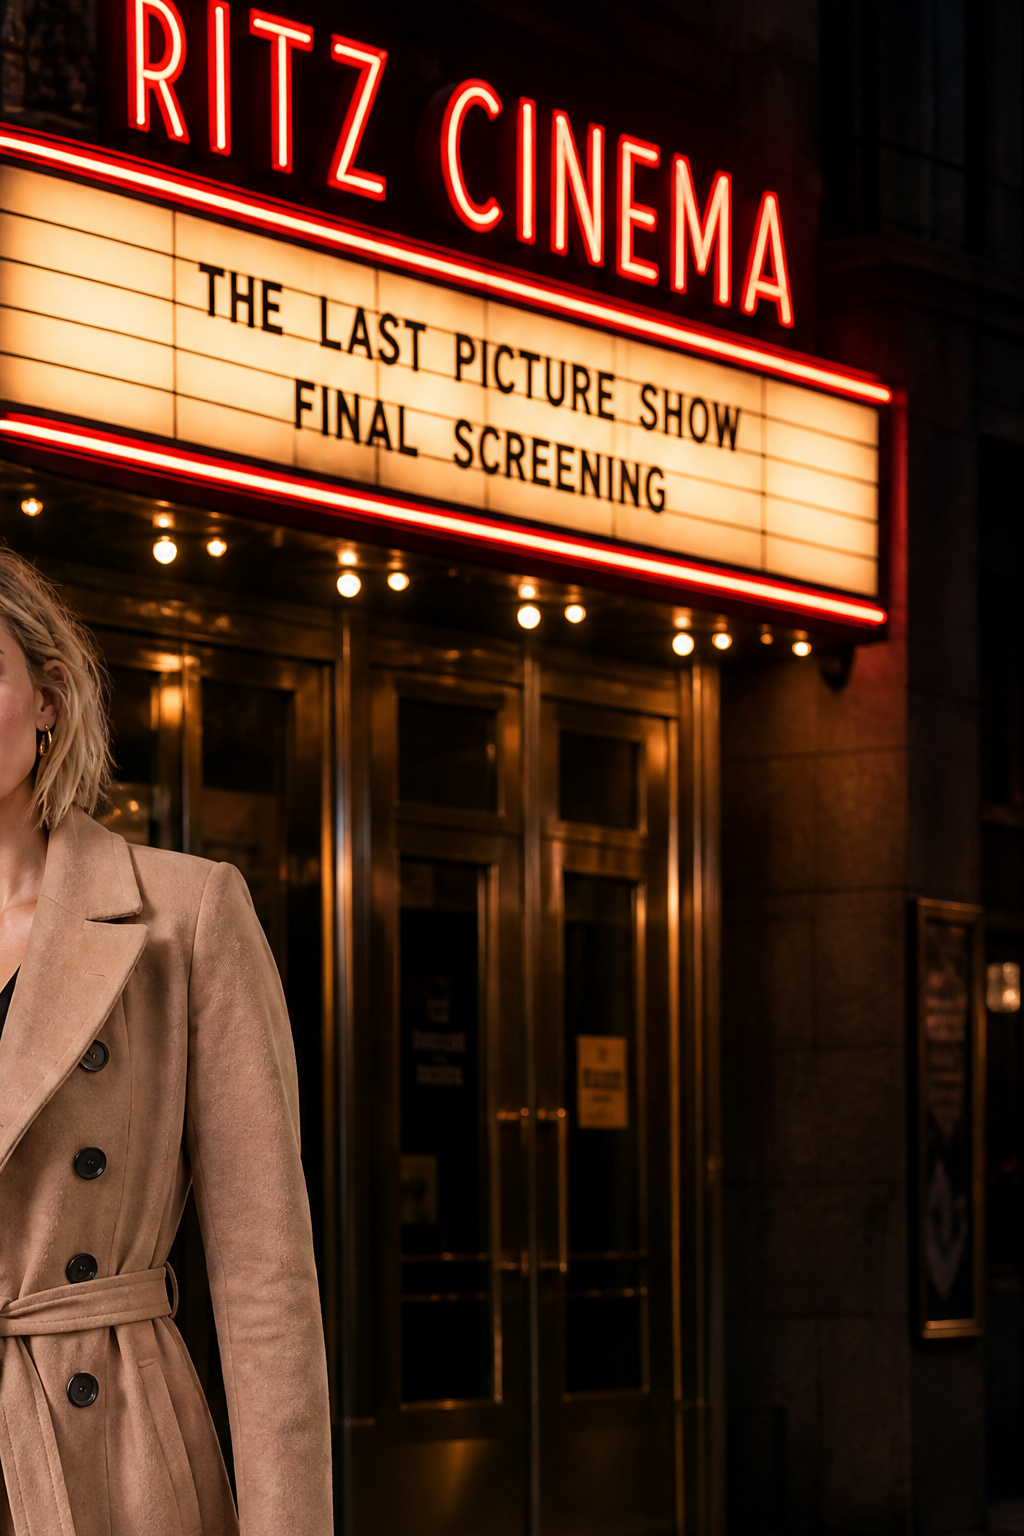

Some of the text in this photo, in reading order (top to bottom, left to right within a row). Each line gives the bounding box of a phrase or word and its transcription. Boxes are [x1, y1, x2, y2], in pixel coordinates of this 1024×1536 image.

[127, 0, 794, 328] RITZ CINEMA
[198, 261, 741, 452] THE LAST PICTURE SHOW
[294, 378, 666, 513] FINAL SCREENING
